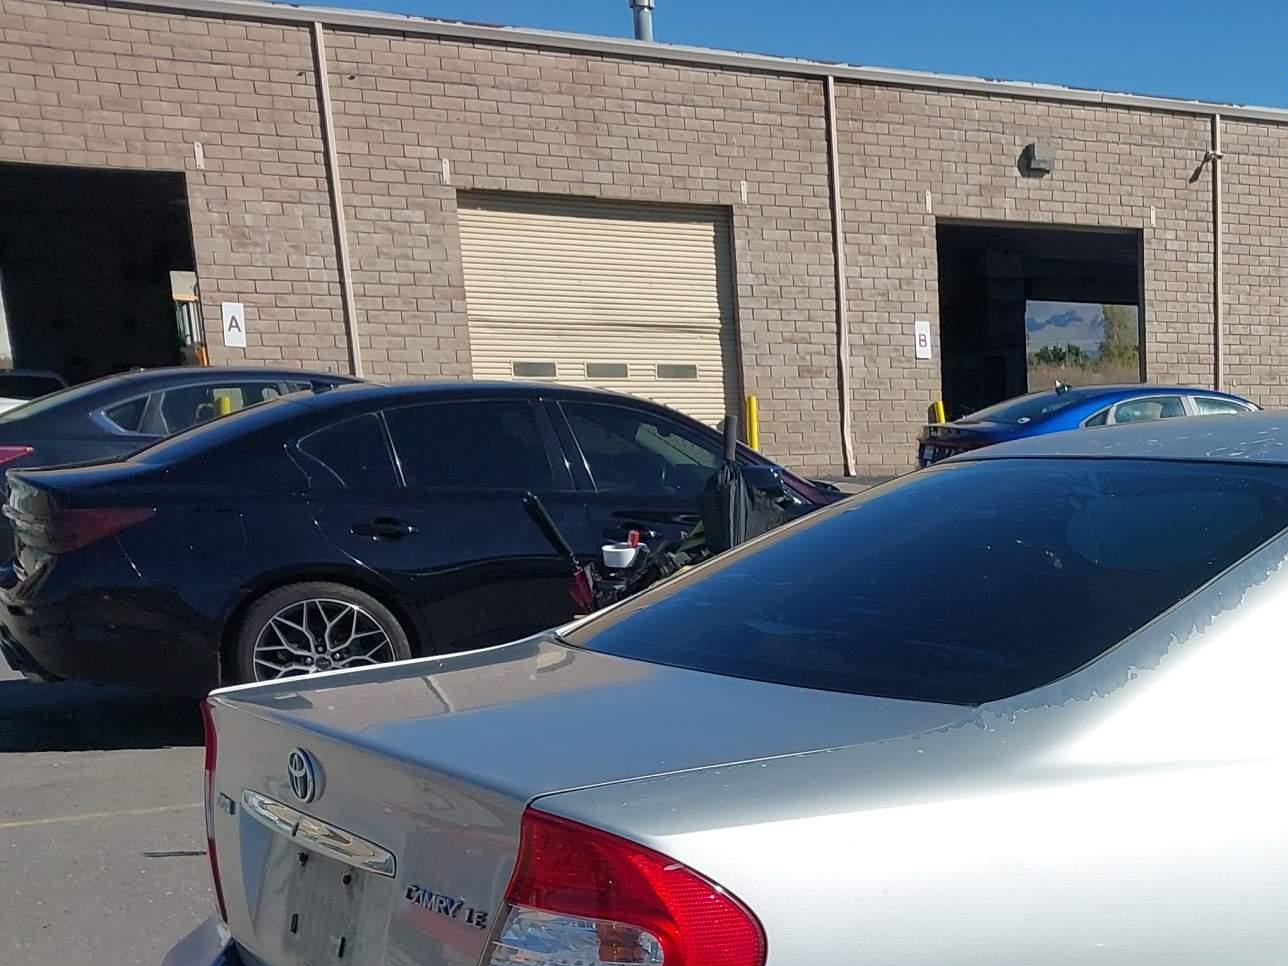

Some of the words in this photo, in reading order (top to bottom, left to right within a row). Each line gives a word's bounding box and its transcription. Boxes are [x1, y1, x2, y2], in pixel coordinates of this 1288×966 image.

[227, 315, 242, 333] A
[918, 333, 928, 348] B
[404, 884, 464, 919] CAMRY
